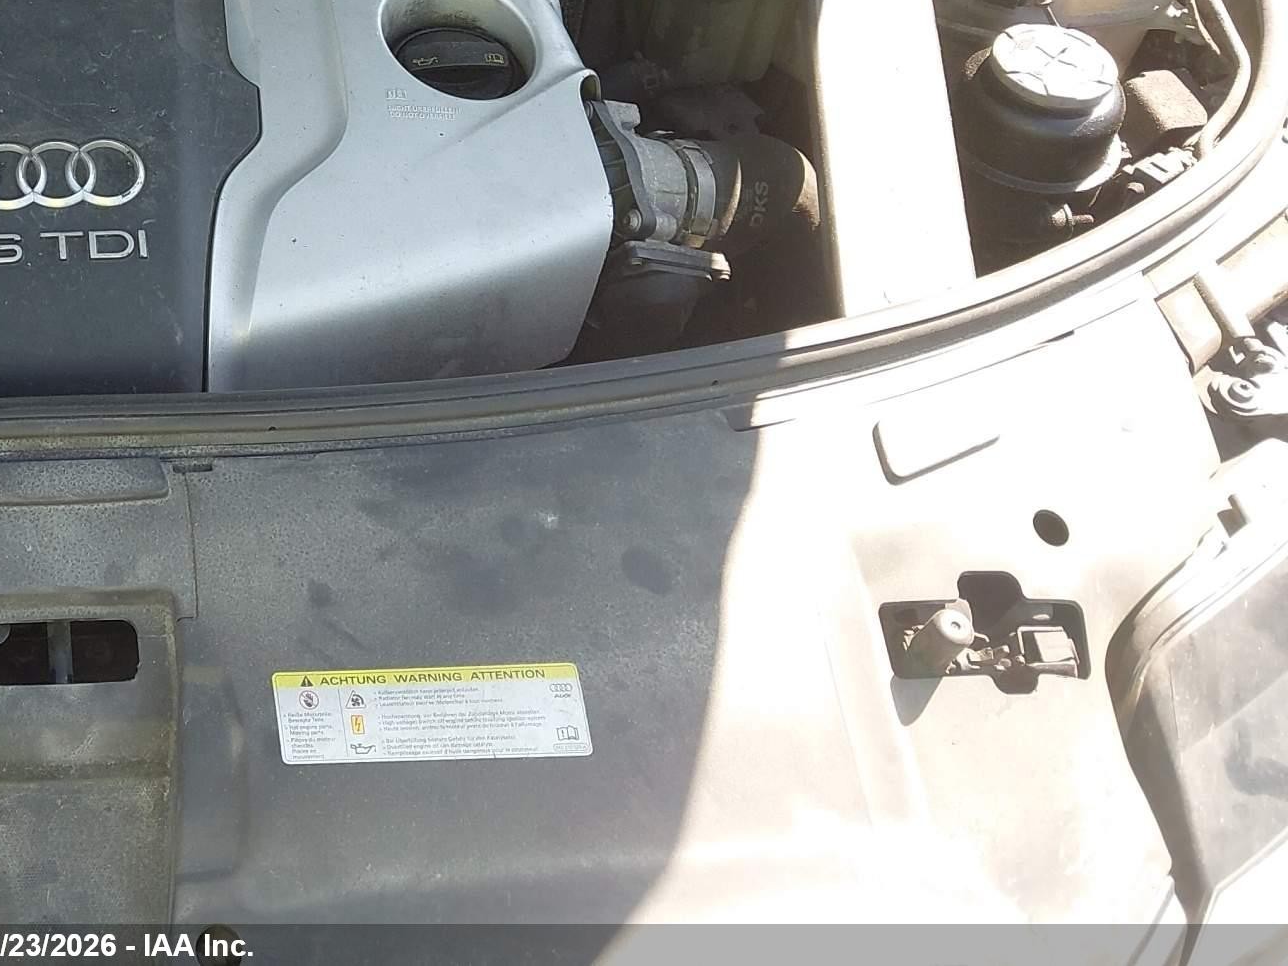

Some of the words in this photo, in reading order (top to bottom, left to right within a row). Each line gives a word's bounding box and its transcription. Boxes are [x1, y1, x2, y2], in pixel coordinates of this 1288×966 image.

[39, 229, 149, 261] TDI
[320, 675, 387, 686] ACHTUNG
[394, 672, 462, 683] WARNING
[470, 669, 546, 681] ATTENTION
